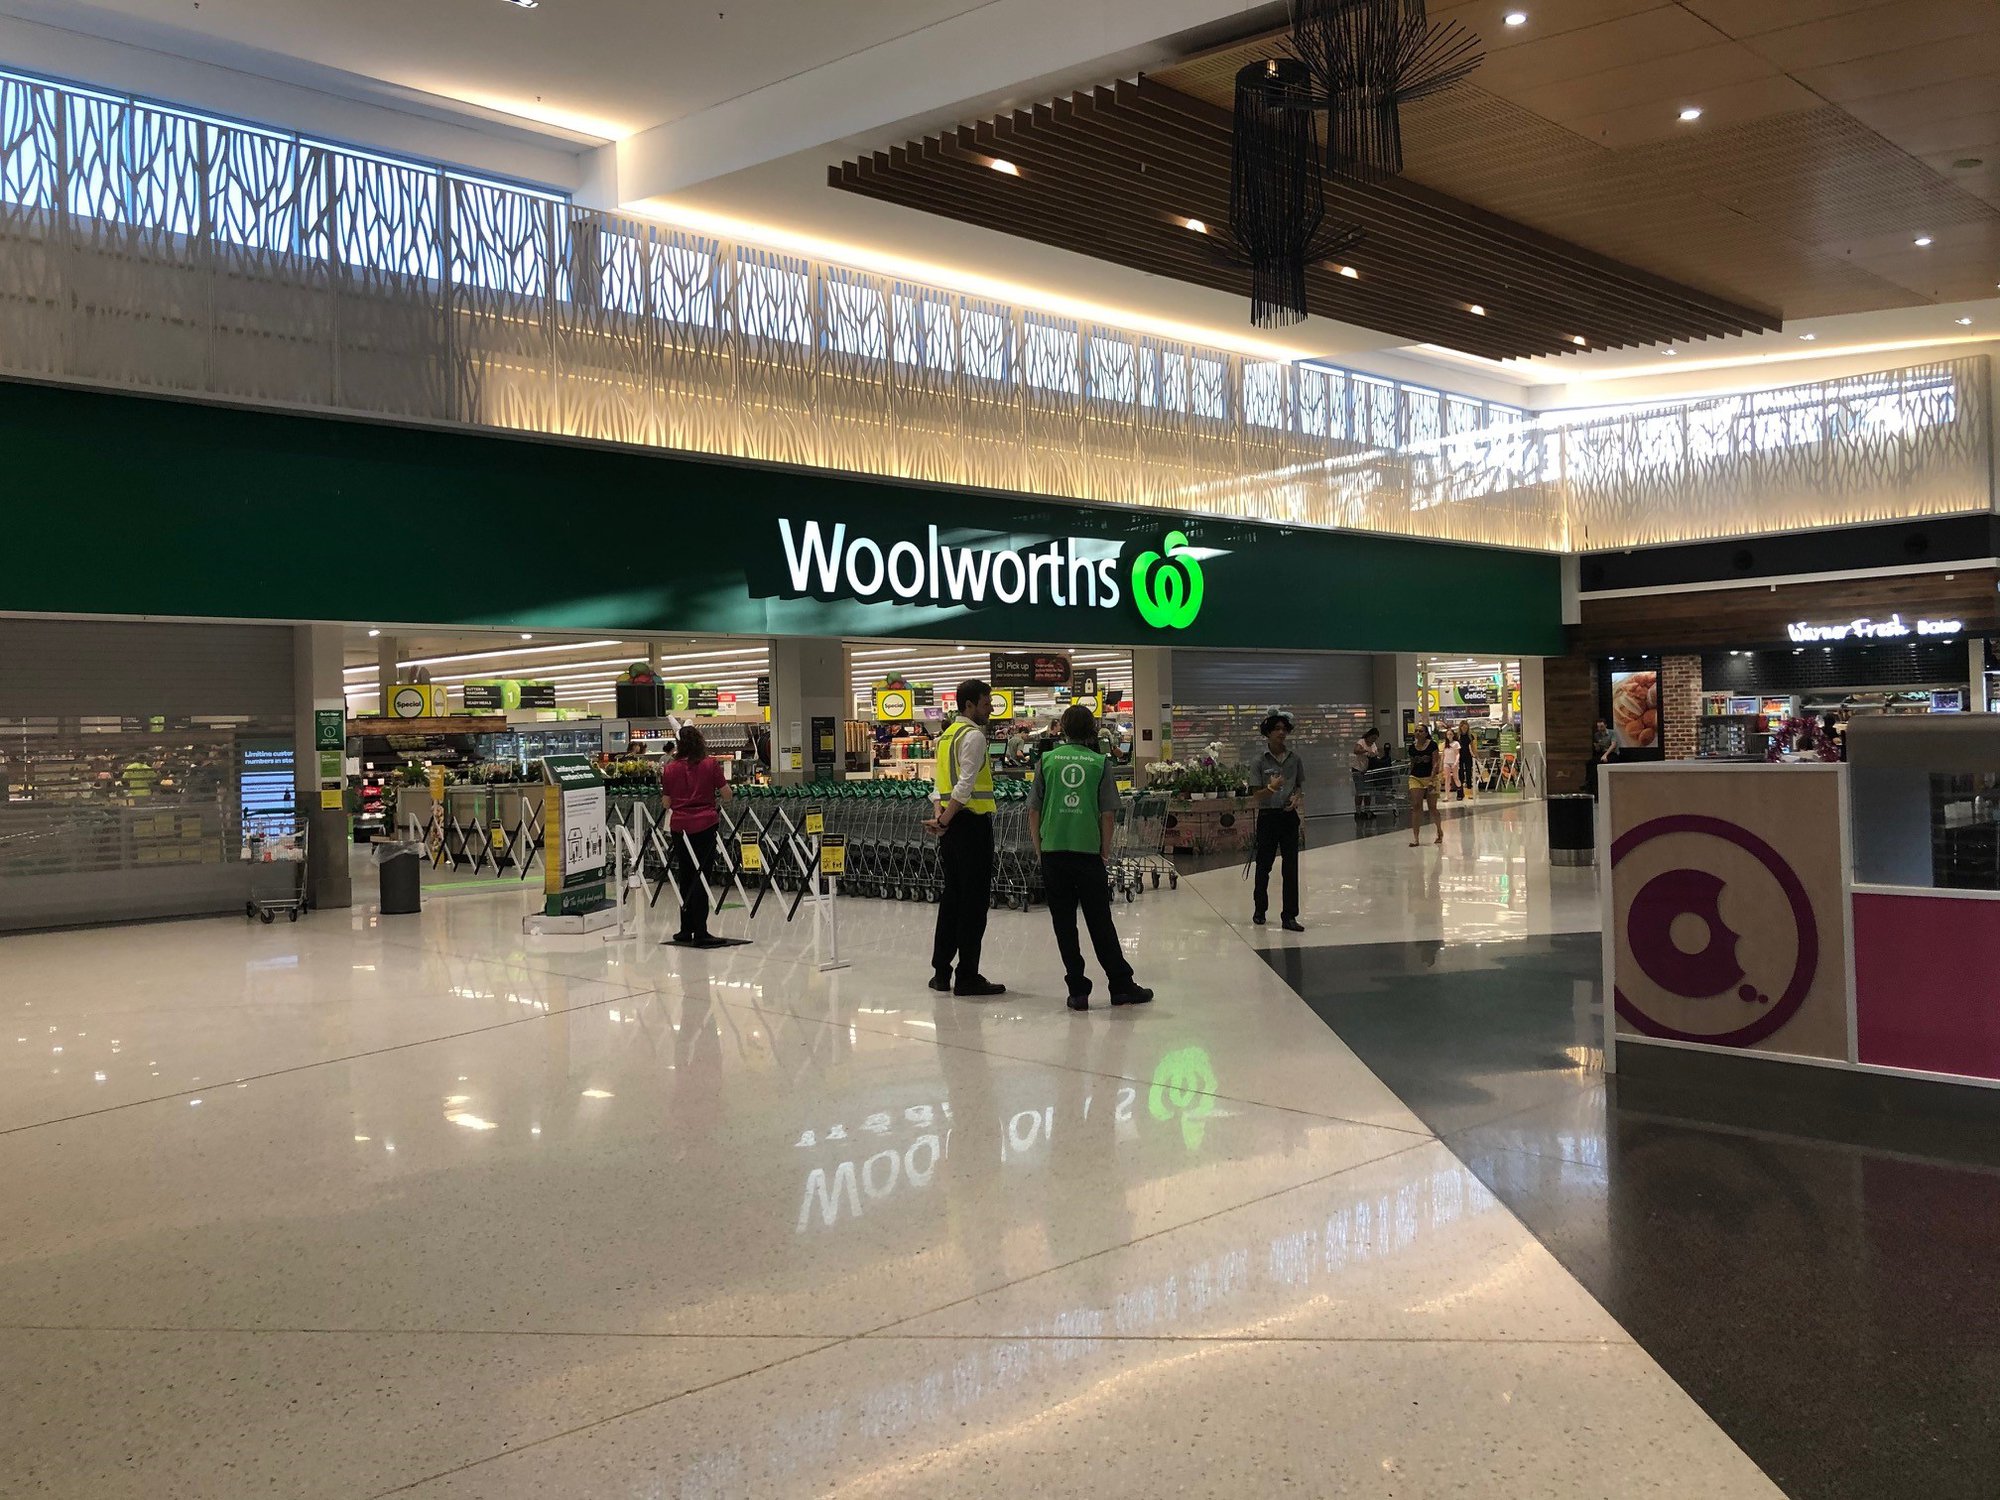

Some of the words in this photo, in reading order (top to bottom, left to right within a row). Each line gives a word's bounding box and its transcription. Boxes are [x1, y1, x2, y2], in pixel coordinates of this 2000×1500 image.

[778, 517, 1120, 609] Woolworths
[1006, 661, 1020, 670] Pick
[1020, 663, 1030, 673] up
[507, 691, 513, 703] 1
[676, 694, 684, 704] 2
[396, 700, 422, 709] Special
